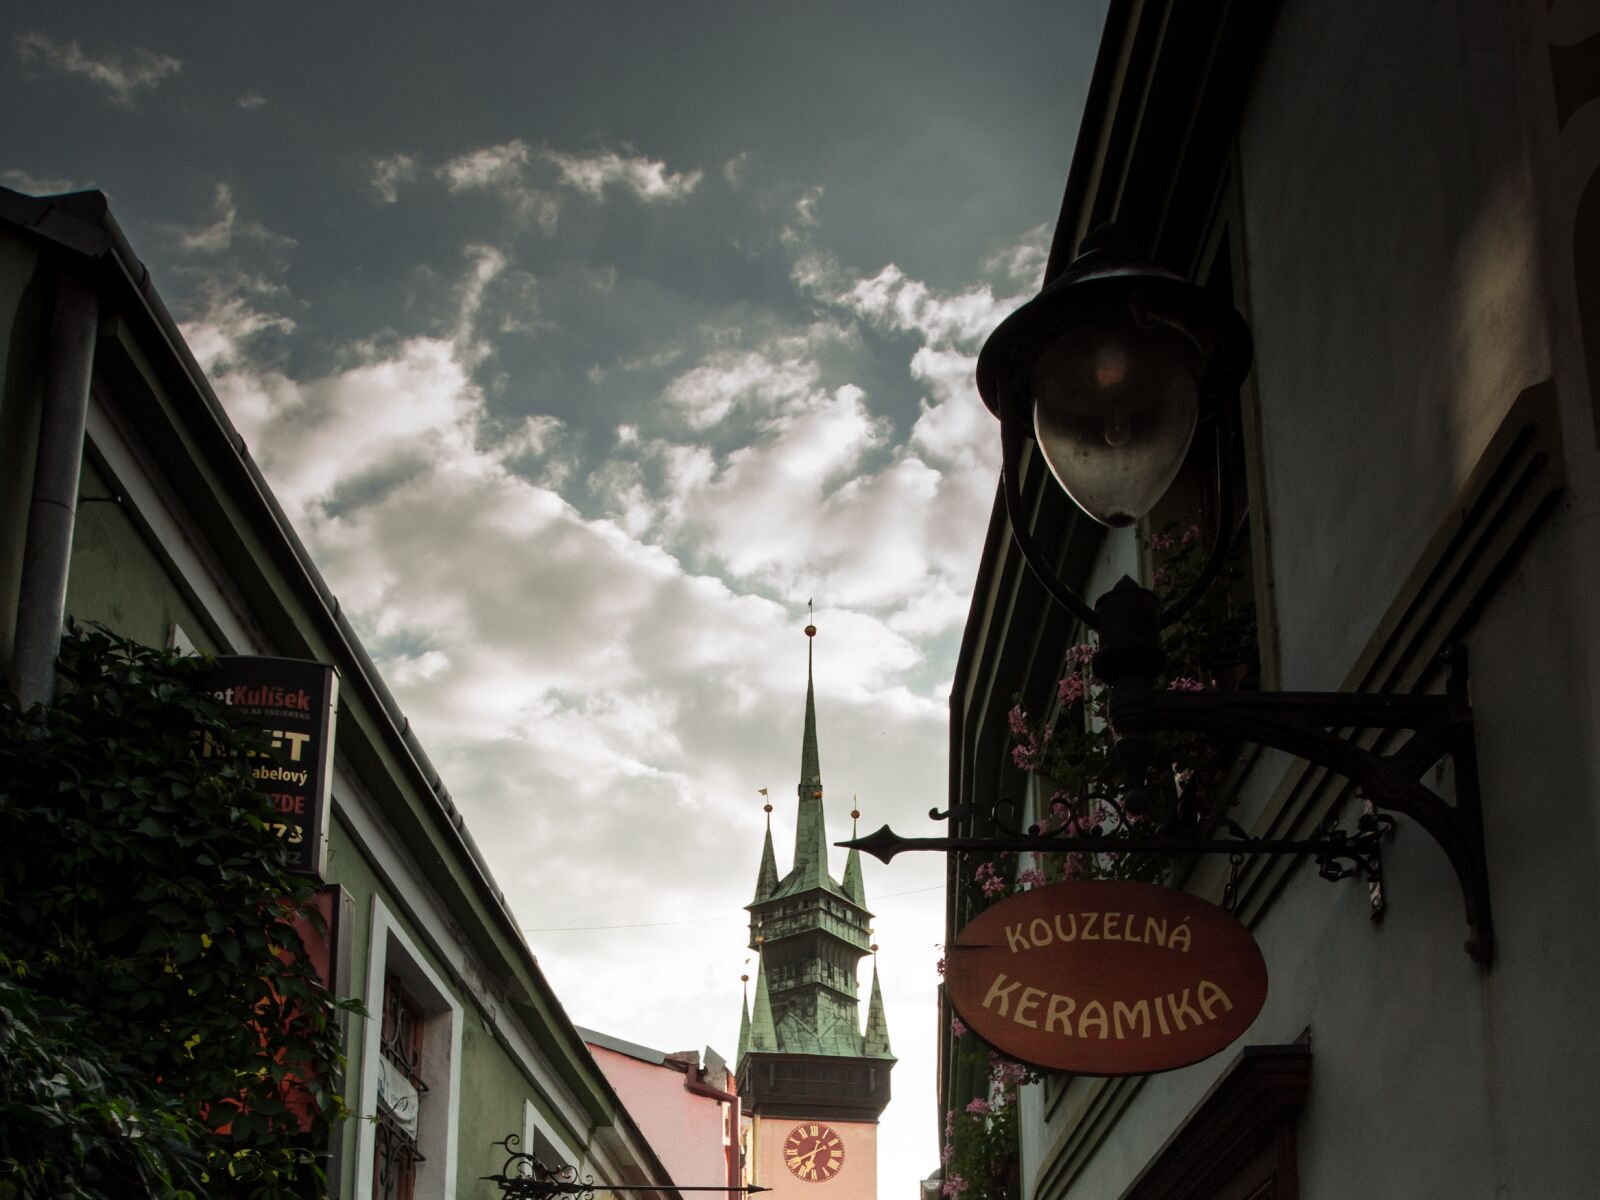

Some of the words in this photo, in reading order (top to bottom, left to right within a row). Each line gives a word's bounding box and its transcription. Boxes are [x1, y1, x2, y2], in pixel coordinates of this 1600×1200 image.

[252, 765, 308, 786] abelový
[1005, 912, 1192, 953] KOUZELNÁ
[982, 973, 1234, 1040] KERAMIKA
